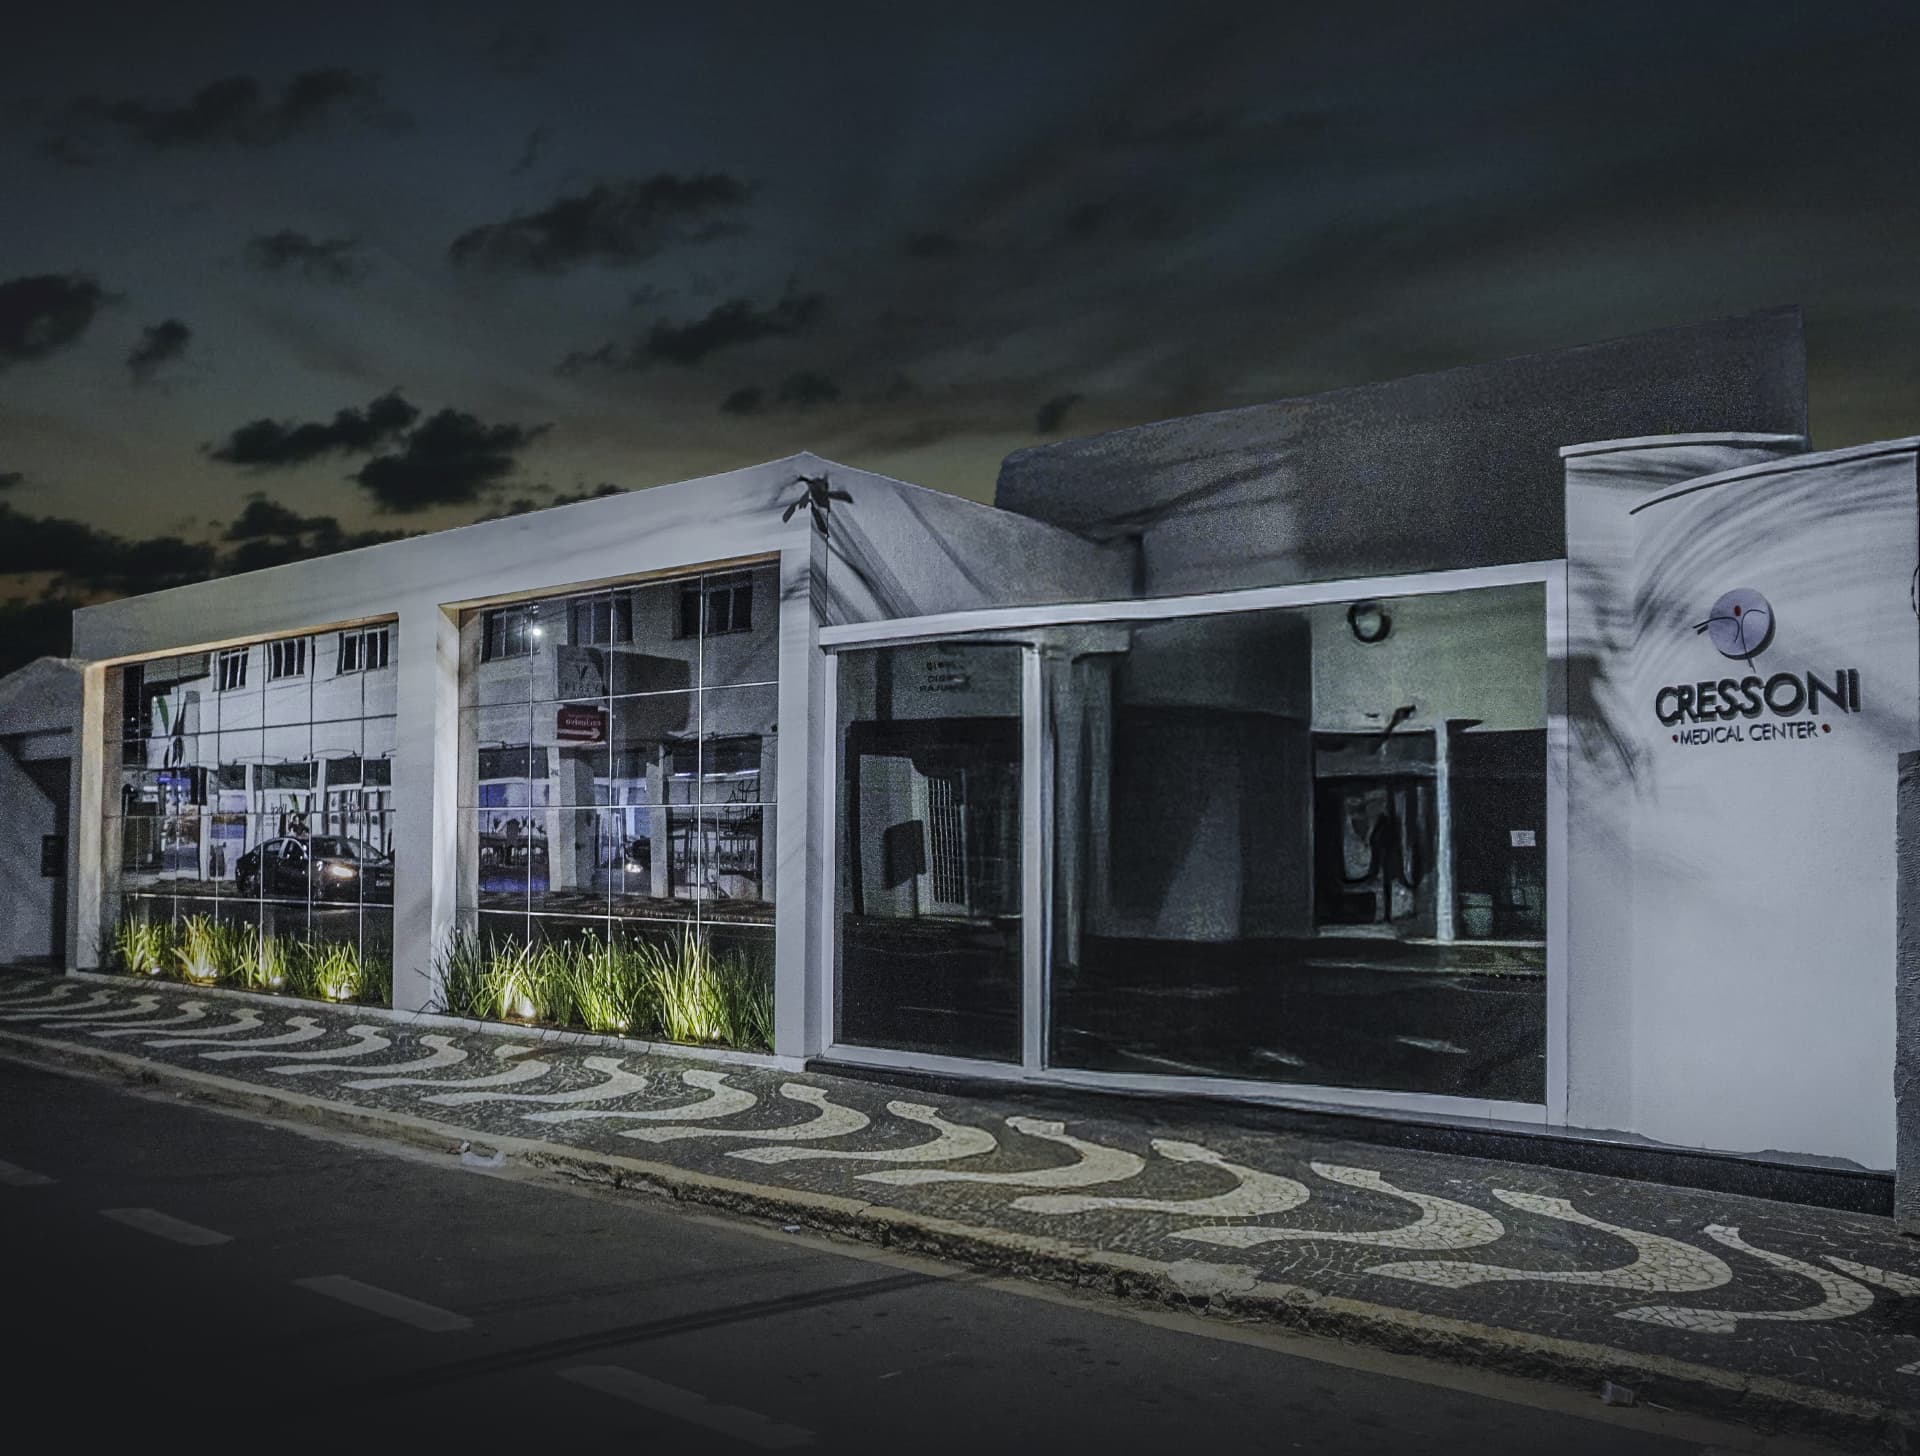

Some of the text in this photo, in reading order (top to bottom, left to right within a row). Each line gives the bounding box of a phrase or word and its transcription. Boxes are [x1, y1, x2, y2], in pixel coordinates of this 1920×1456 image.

[1656, 668, 1861, 727] CRESSONI
[1680, 721, 1819, 745] MEDICAL CENTER
